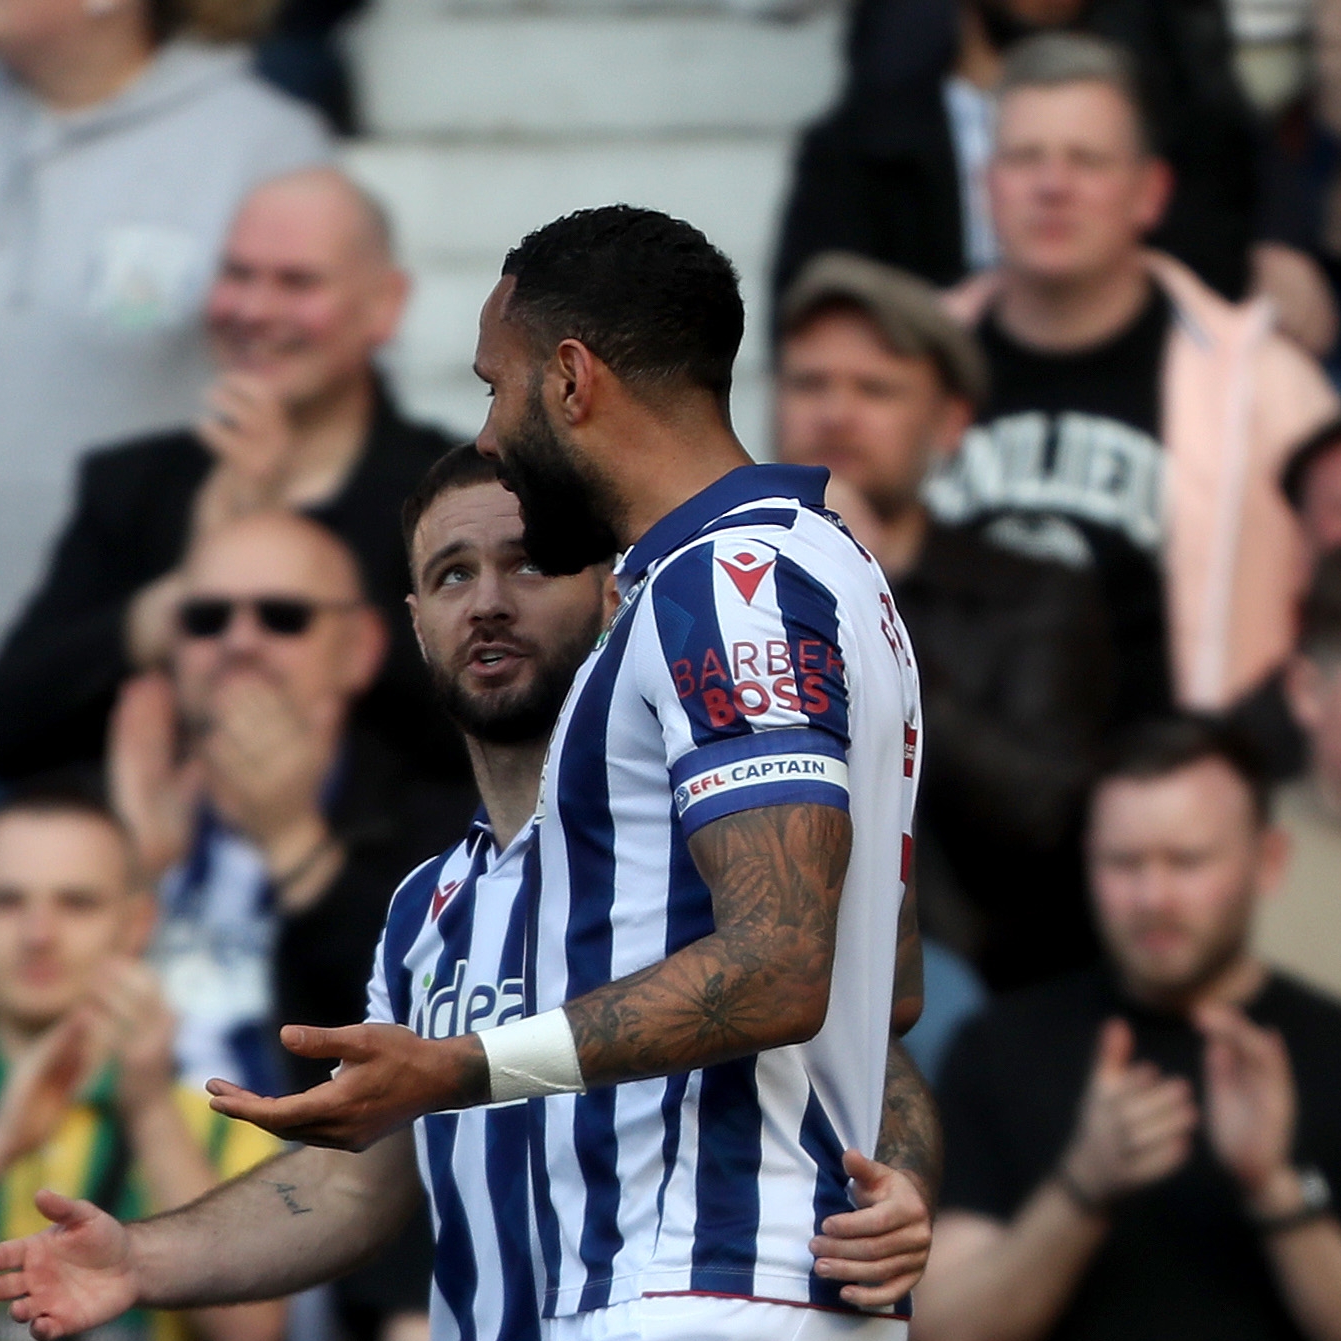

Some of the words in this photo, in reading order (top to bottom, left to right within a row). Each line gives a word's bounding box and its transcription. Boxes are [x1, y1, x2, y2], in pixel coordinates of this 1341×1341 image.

[702, 675, 831, 728] BOSS
[689, 772, 726, 796] EFL
[731, 759, 826, 783] CAPTAIN
